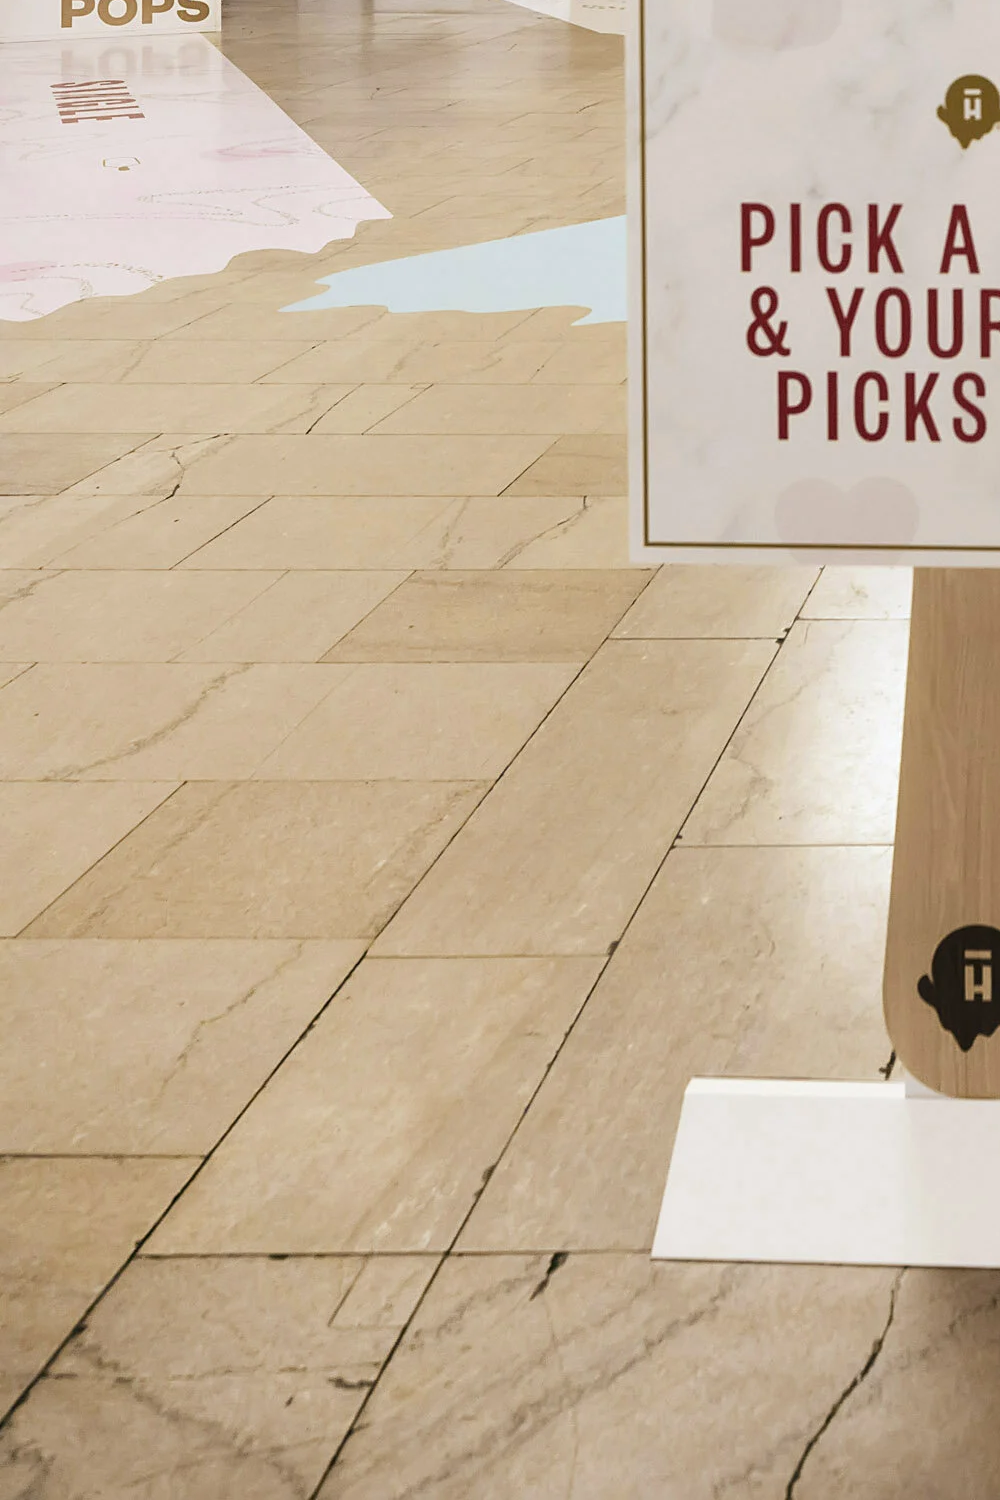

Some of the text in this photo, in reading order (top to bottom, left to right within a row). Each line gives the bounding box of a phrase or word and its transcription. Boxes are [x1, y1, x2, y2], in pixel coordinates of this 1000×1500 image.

[740, 203, 904, 274] PICK
[940, 204, 980, 274] A
[746, 286, 791, 357] &
[777, 370, 989, 443] PICKS
